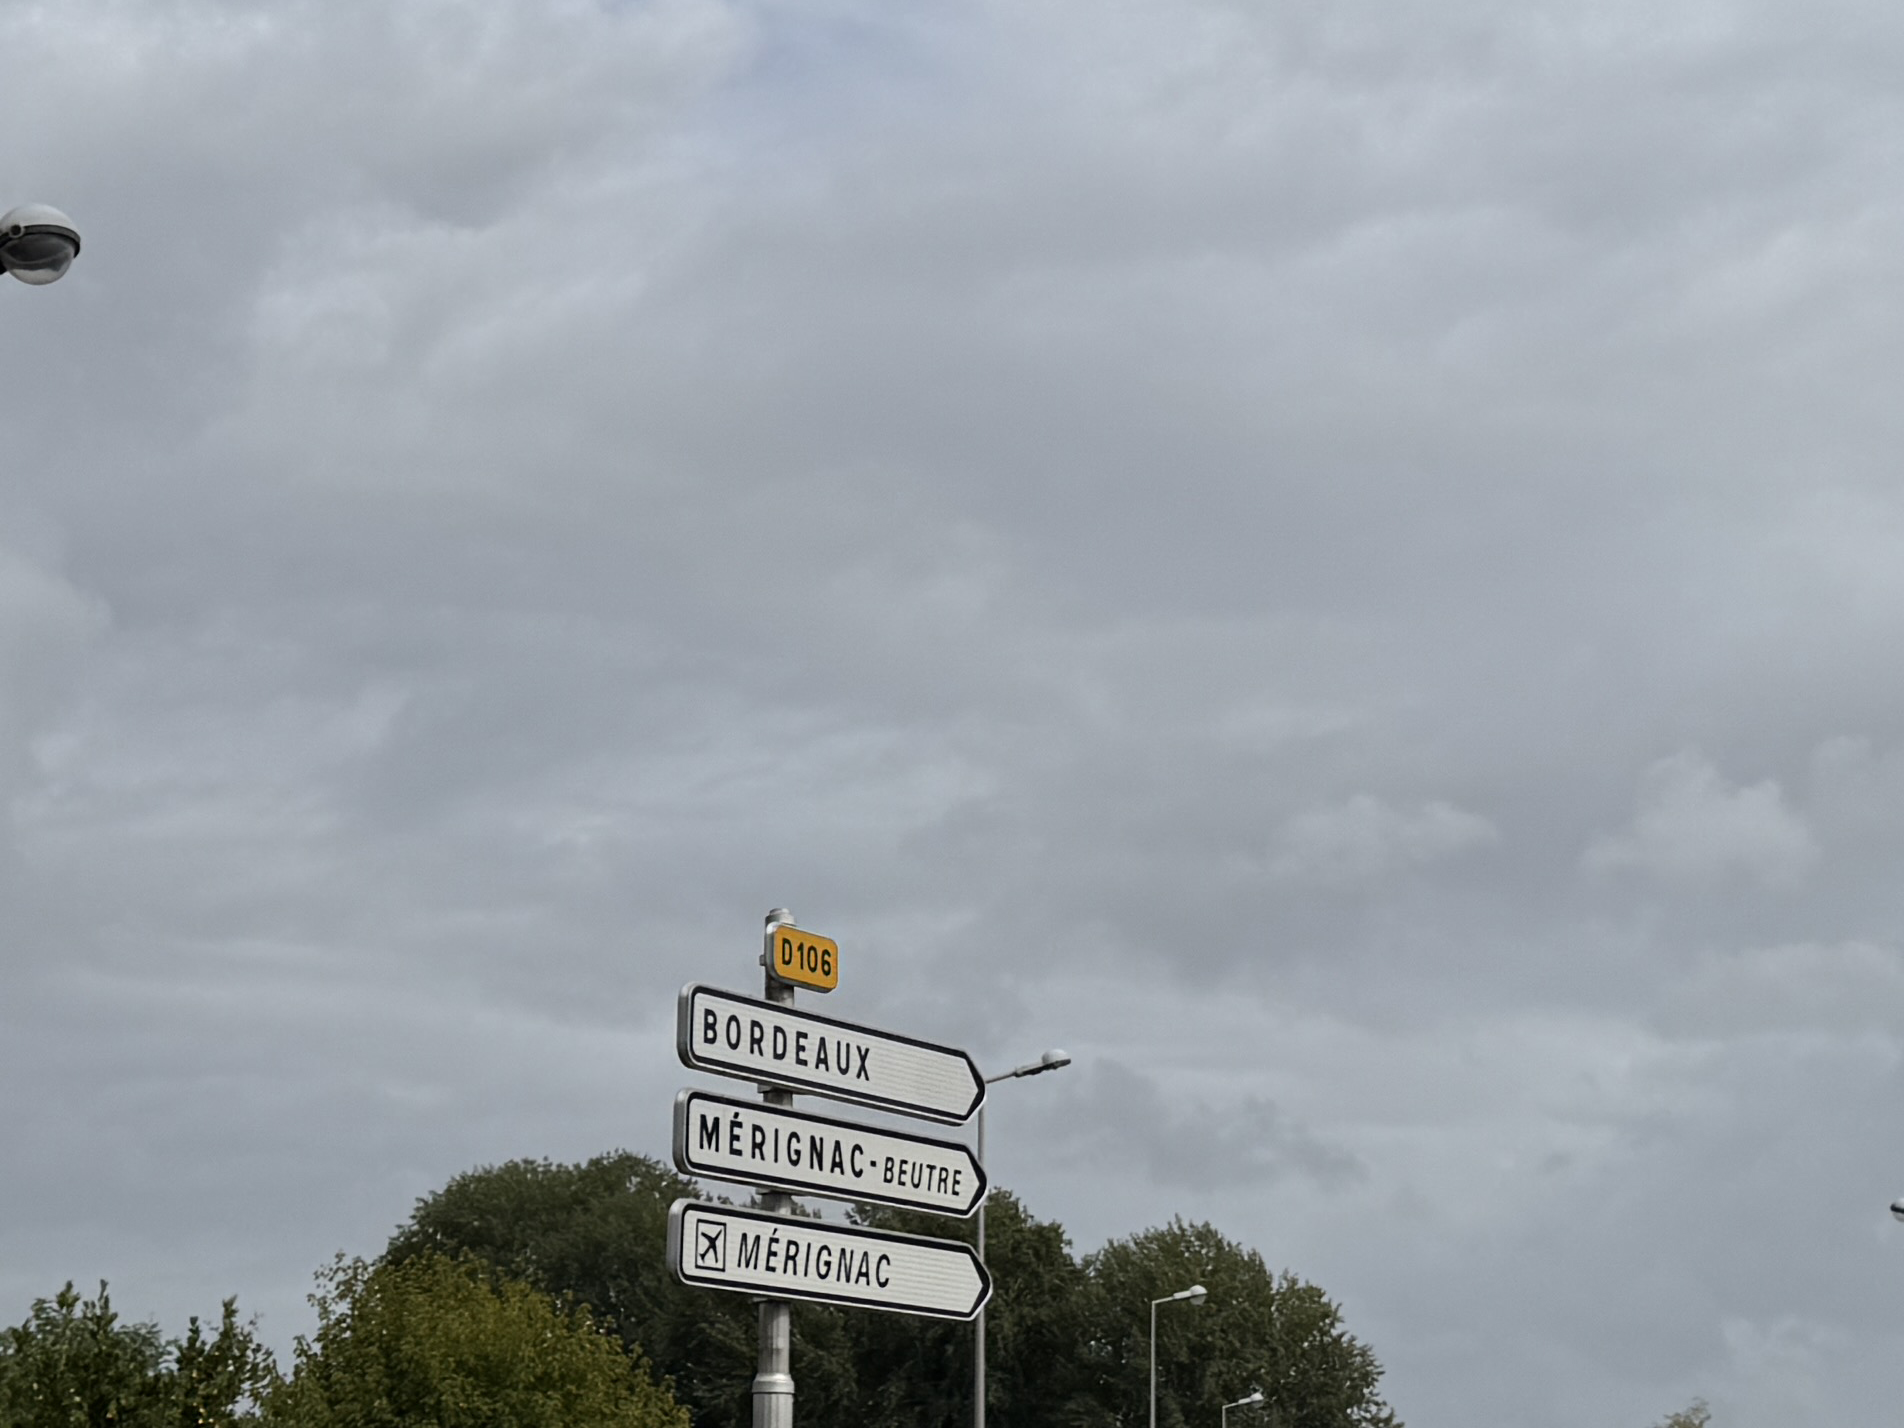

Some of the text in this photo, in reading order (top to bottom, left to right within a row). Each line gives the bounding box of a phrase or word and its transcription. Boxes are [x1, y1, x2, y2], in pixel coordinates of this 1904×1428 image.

[781, 937, 832, 977] D106
[702, 1008, 871, 1082] BORDEAUX
[698, 1111, 963, 1198] MÉRIGNAC-BEUTRE
[736, 1227, 892, 1289] MÉRIGNAC
